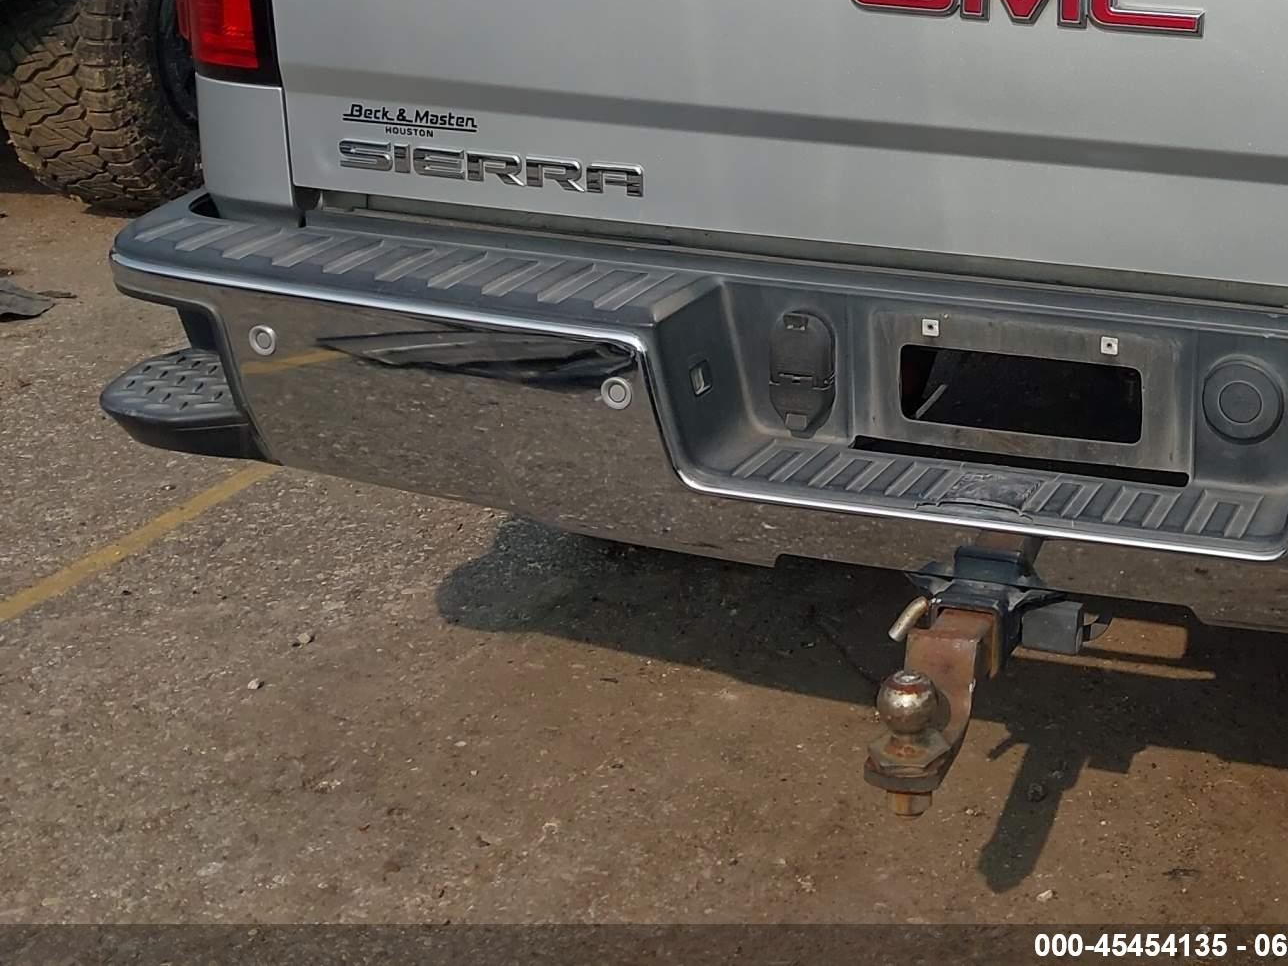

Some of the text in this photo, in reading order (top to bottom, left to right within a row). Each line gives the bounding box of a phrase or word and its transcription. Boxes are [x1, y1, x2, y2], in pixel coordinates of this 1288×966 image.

[343, 104, 477, 129] Beck & Masten
[385, 126, 434, 138] HOUSTON
[339, 138, 644, 197] SIERRA
